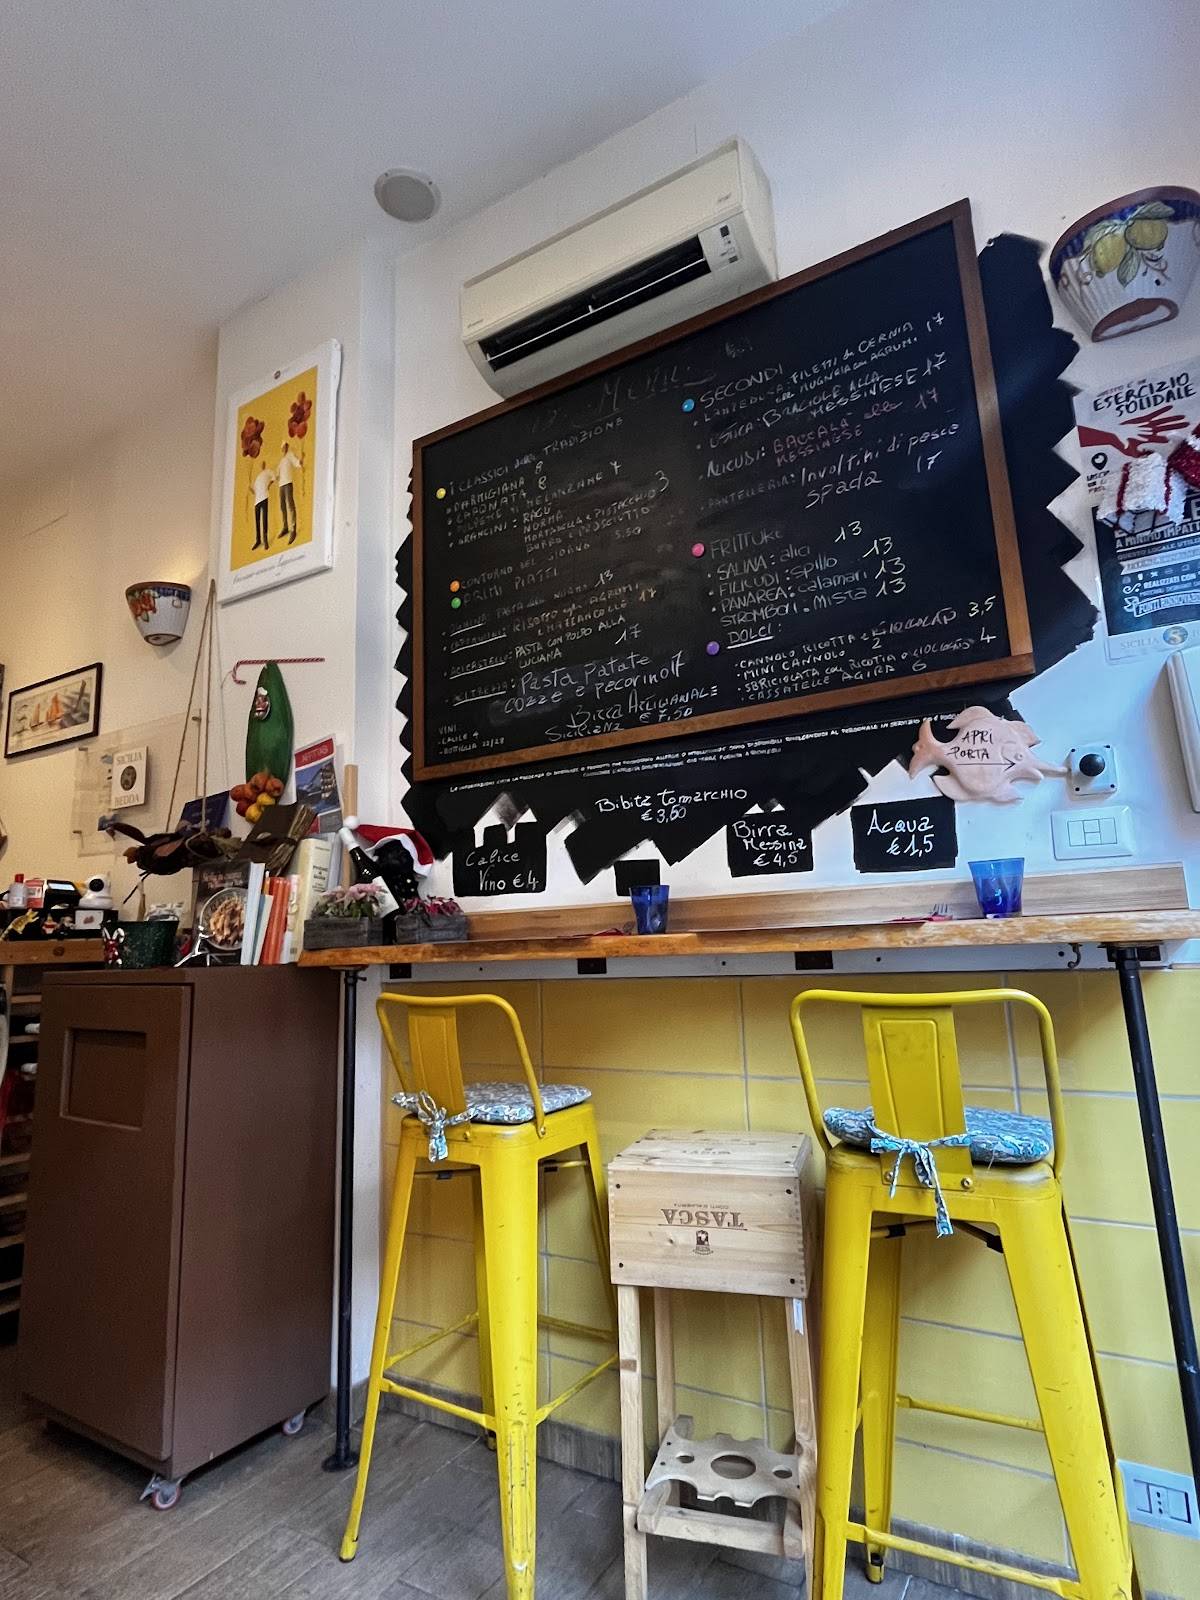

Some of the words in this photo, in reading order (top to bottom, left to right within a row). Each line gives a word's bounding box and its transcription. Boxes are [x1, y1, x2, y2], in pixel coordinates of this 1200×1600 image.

[926, 312, 945, 332] 17
[922, 351, 947, 377] 17
[700, 363, 783, 408] SECONDI
[1093, 372, 1189, 412] ESERCIZIO
[914, 387, 939, 410] 17
[1115, 383, 1197, 417] SOLIDALE
[916, 451, 943, 472] 17
[834, 520, 863, 543] 13
[862, 536, 894, 558] 13
[594, 569, 614, 588] 13
[875, 557, 906, 580] 13
[875, 577, 907, 597] 13
[968, 595, 996, 617] 3,5
[598, 614, 625, 632] ALLA
[615, 623, 641, 645] 17
[980, 626, 997, 644] 4
[744, 664, 775, 680] MINI
[871, 637, 882, 649] 2
[961, 728, 993, 745] APRI
[946, 746, 990, 761] PORTA
[732, 820, 793, 838] Birra
[866, 808, 934, 836] Acqua
[660, 1208, 744, 1228] TASCA
